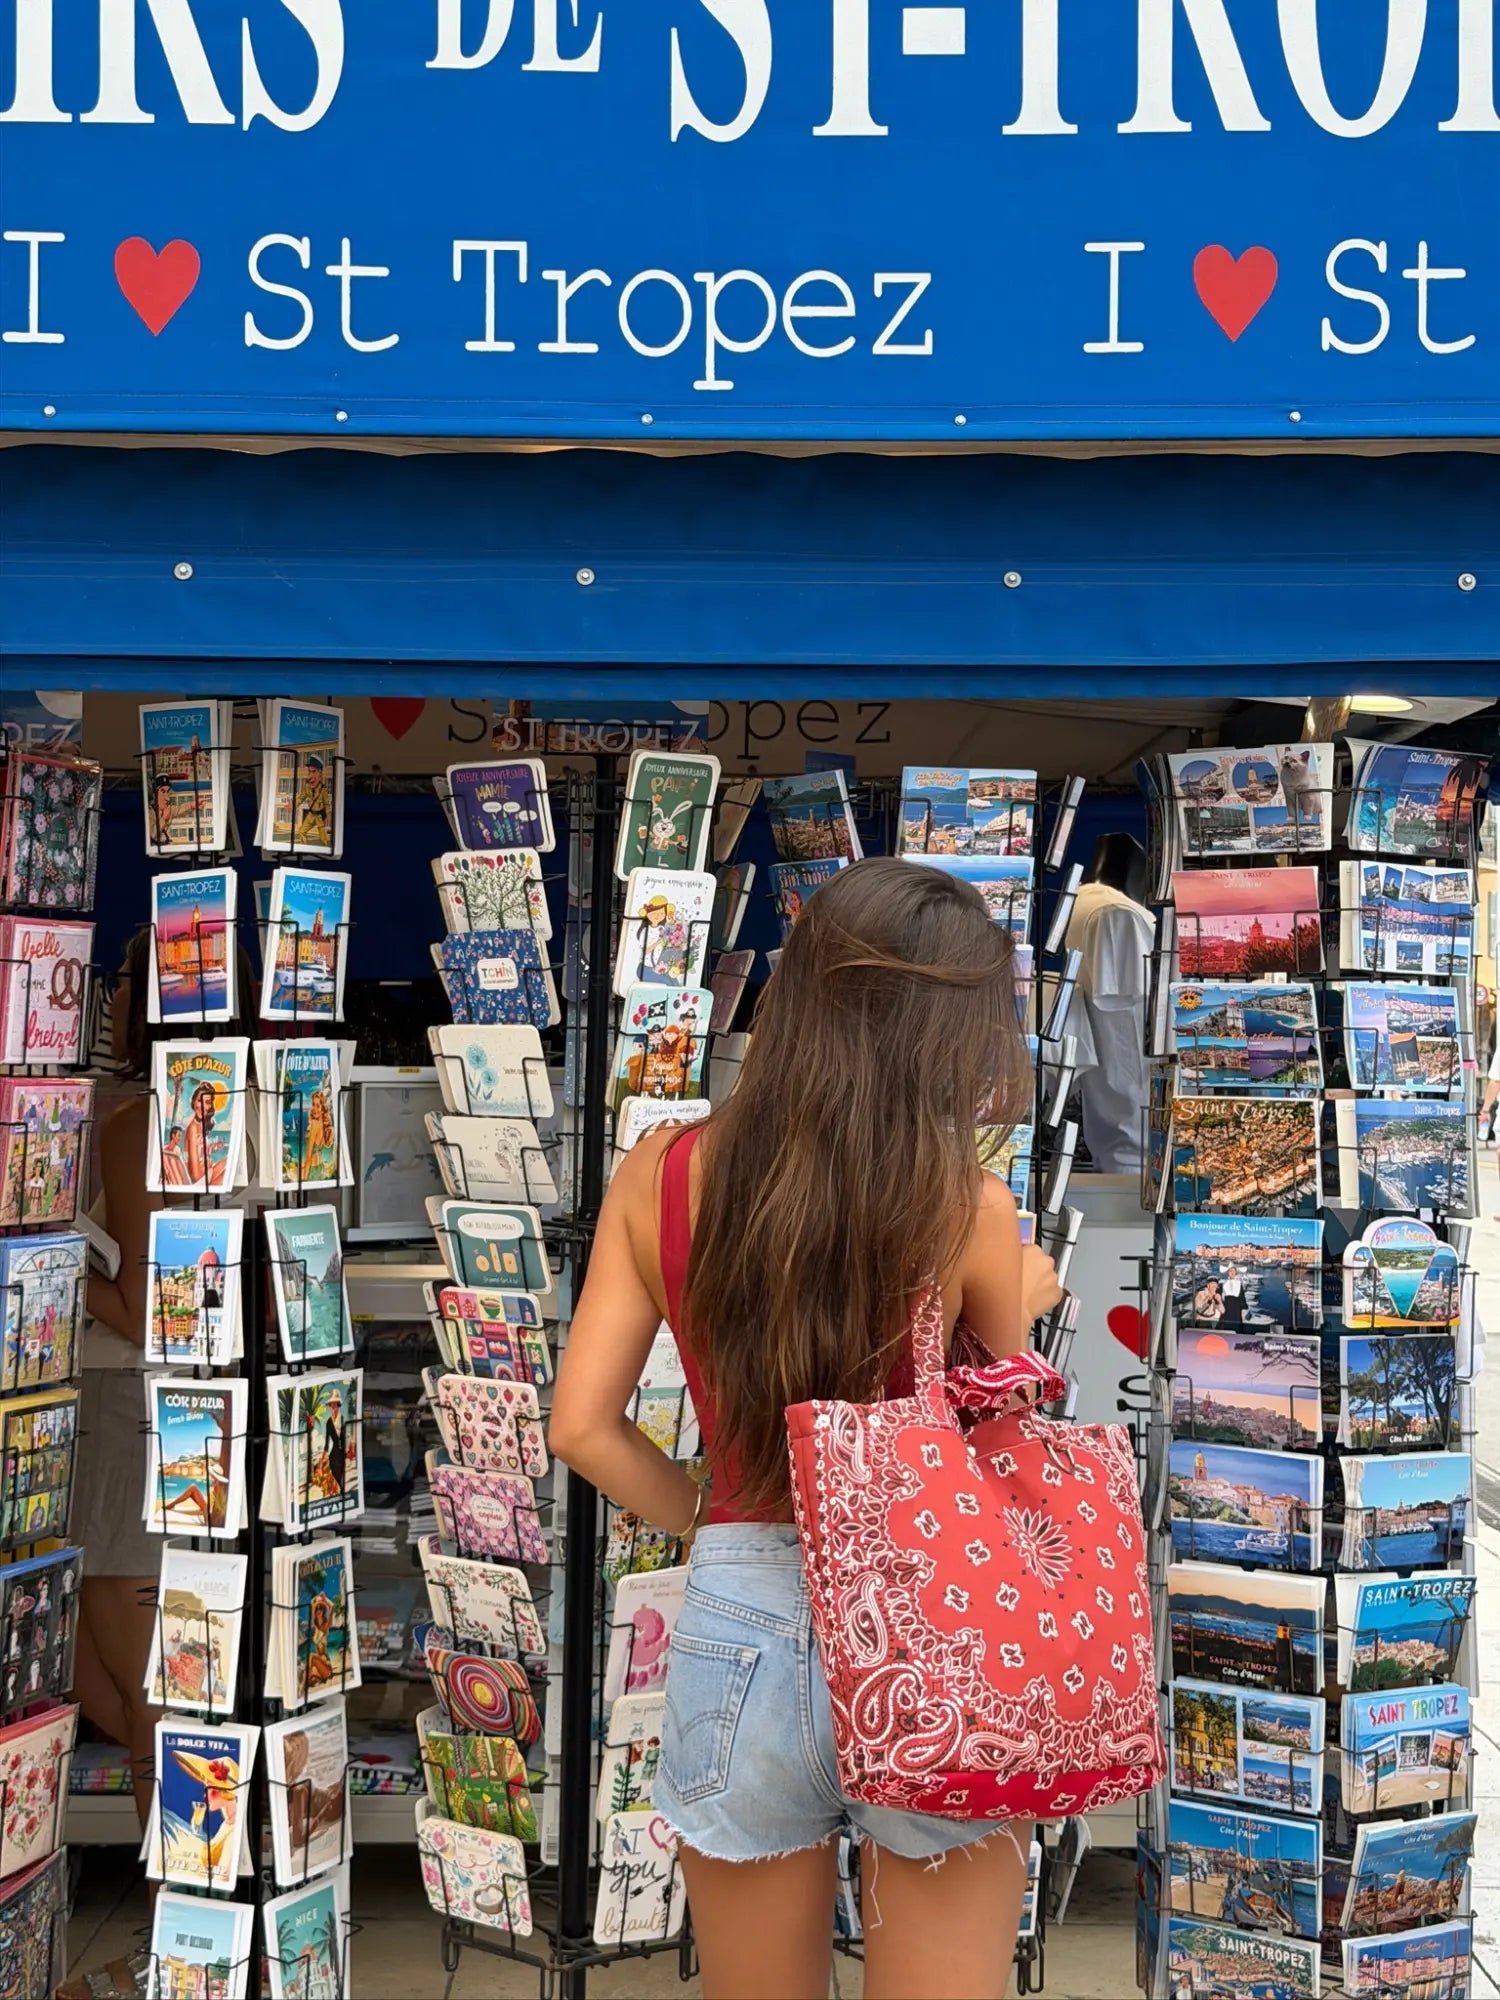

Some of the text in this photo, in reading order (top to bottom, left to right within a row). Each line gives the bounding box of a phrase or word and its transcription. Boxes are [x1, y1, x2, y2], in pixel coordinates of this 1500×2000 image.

[1083, 238, 1476, 356] I St
[3, 231, 933, 391] I St Tropez
[147, 714, 205, 731] SAINT-TROPEZ
[644, 763, 666, 774] JOYEUX
[161, 879, 220, 901] SAINT-TROPEZ
[288, 880, 343, 899] SAINT-TROPEZ
[168, 1055, 233, 1079] CÔTE D'AZUR
[1177, 1100, 1295, 1125] Saint Tropez
[1414, 1104, 1462, 1118] Saint-Tropez
[1189, 1220, 1229, 1232] Bonjour
[1230, 1221, 1242, 1231] de
[1243, 1222, 1305, 1237] Saint-Tropez
[1263, 1342, 1312, 1354] Saint-Tropez
[1365, 1580, 1473, 1604] SAINT-TROPEZ
[1209, 1656, 1278, 1675] SAINT TROPEZ
[1222, 1666, 1239, 1677] Côte
[1369, 1694, 1459, 1727] SAINT TROPEZ
[166, 1736, 177, 1746] La
[177, 1737, 207, 1749] DOLCE
[1208, 1814, 1272, 1833] SAINT TROPEZ
[1219, 1935, 1306, 1969] SAINT-TROPEZ
